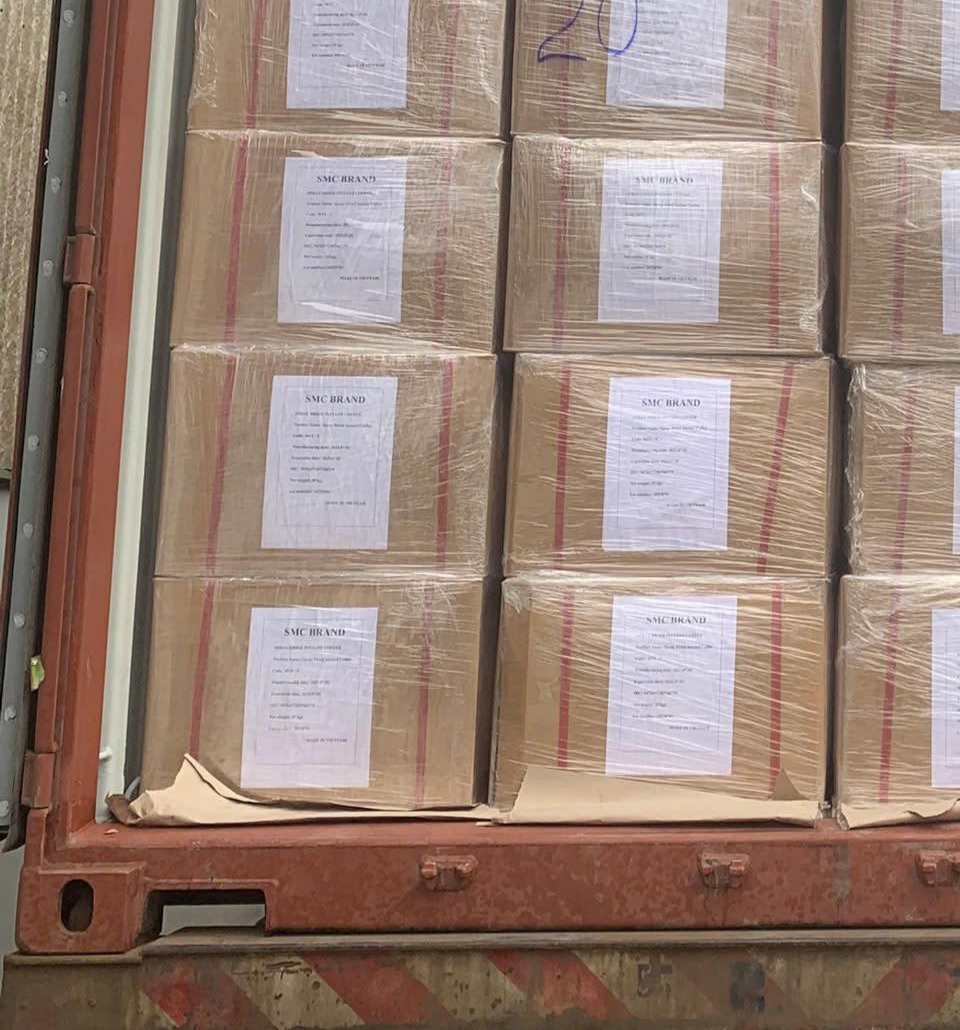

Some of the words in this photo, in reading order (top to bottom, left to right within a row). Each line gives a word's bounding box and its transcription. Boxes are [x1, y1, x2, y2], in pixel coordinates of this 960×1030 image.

[316, 174, 339, 183] SMC
[341, 174, 377, 184] BRAND
[636, 176, 657, 184] SMC
[660, 176, 693, 185] BRAND
[305, 394, 328, 403] SMC
[330, 394, 366, 404] BRAND
[641, 398, 664, 407] SMC
[665, 398, 701, 408] BRAND
[646, 615, 669, 625] SMC
[672, 615, 706, 625] BRAND
[284, 627, 307, 637] SMC
[310, 627, 346, 637] BRAND
